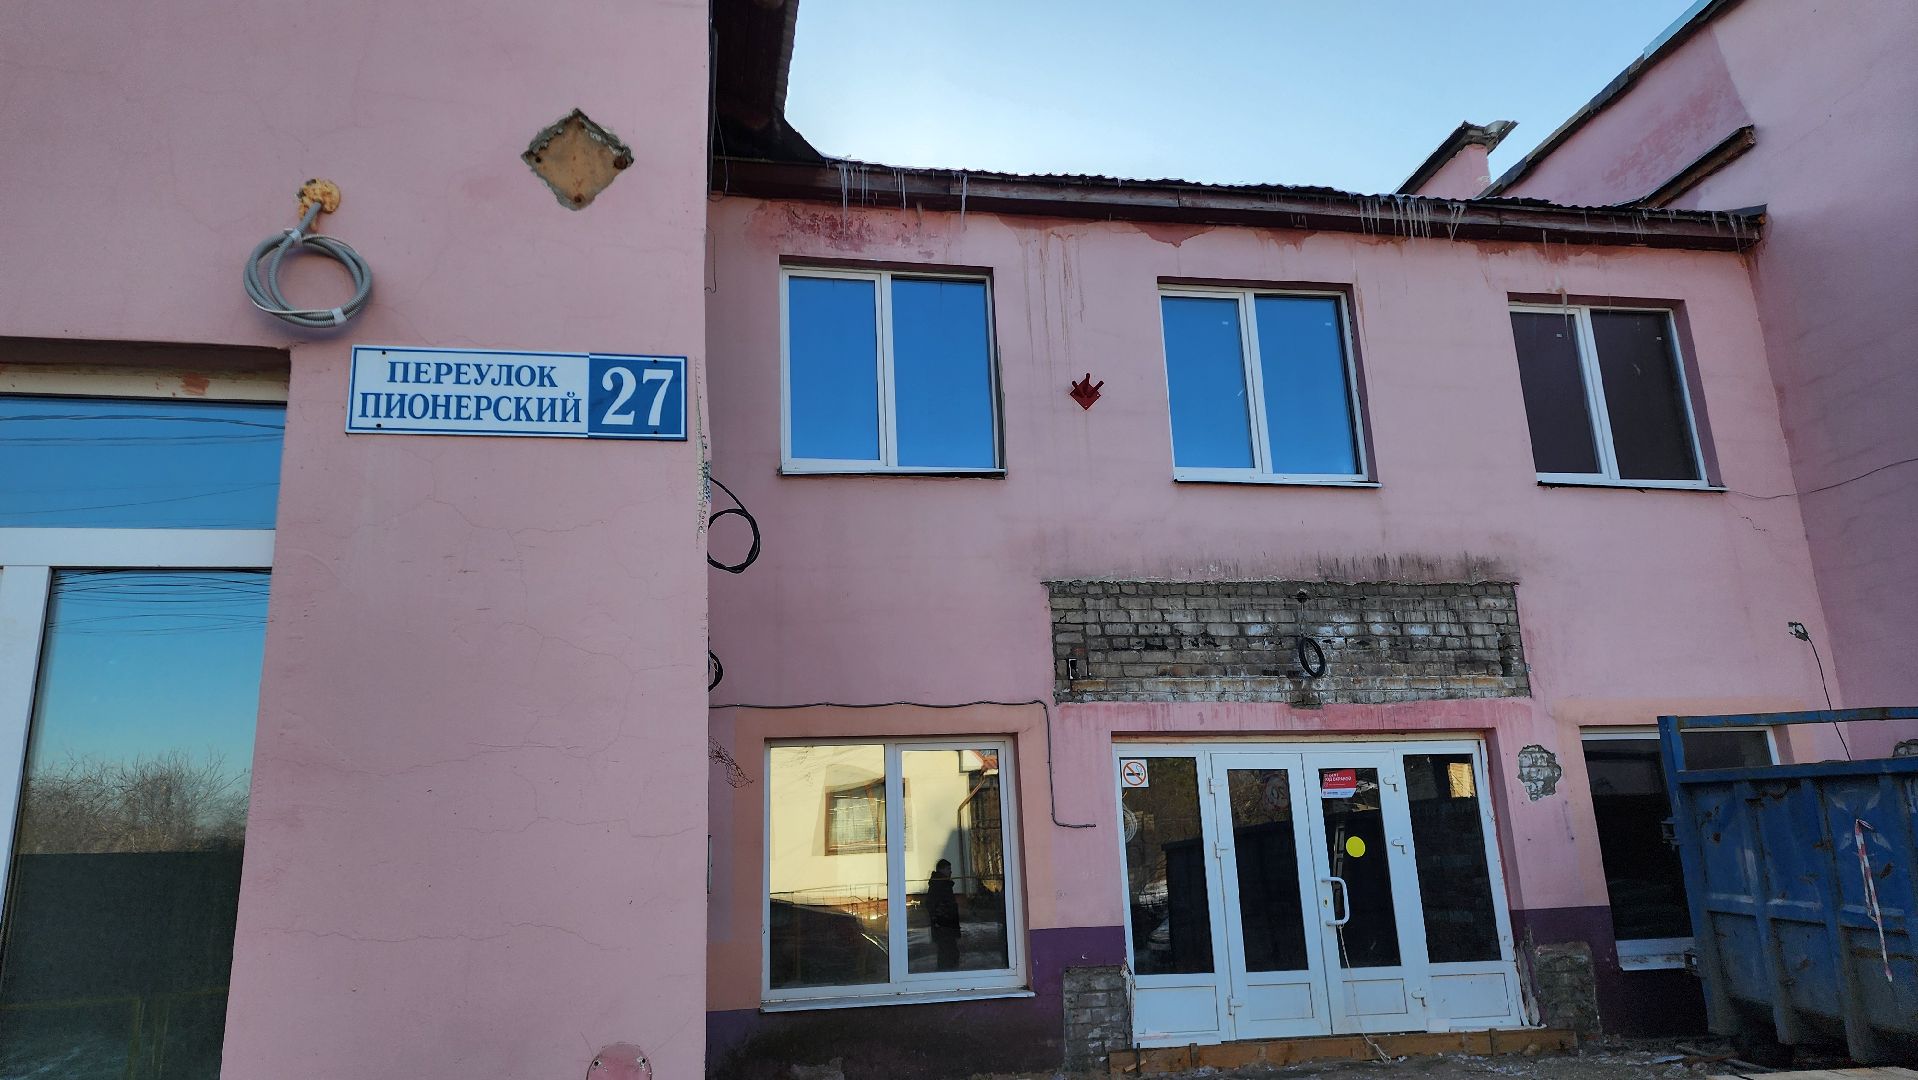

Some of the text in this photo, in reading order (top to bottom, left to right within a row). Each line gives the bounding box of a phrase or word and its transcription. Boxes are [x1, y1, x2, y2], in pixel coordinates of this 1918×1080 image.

[387, 361, 558, 388] ПЕРЕУЛОК
[358, 391, 582, 423] ПИОНЕРСКИЙ
[601, 366, 674, 426] 27
